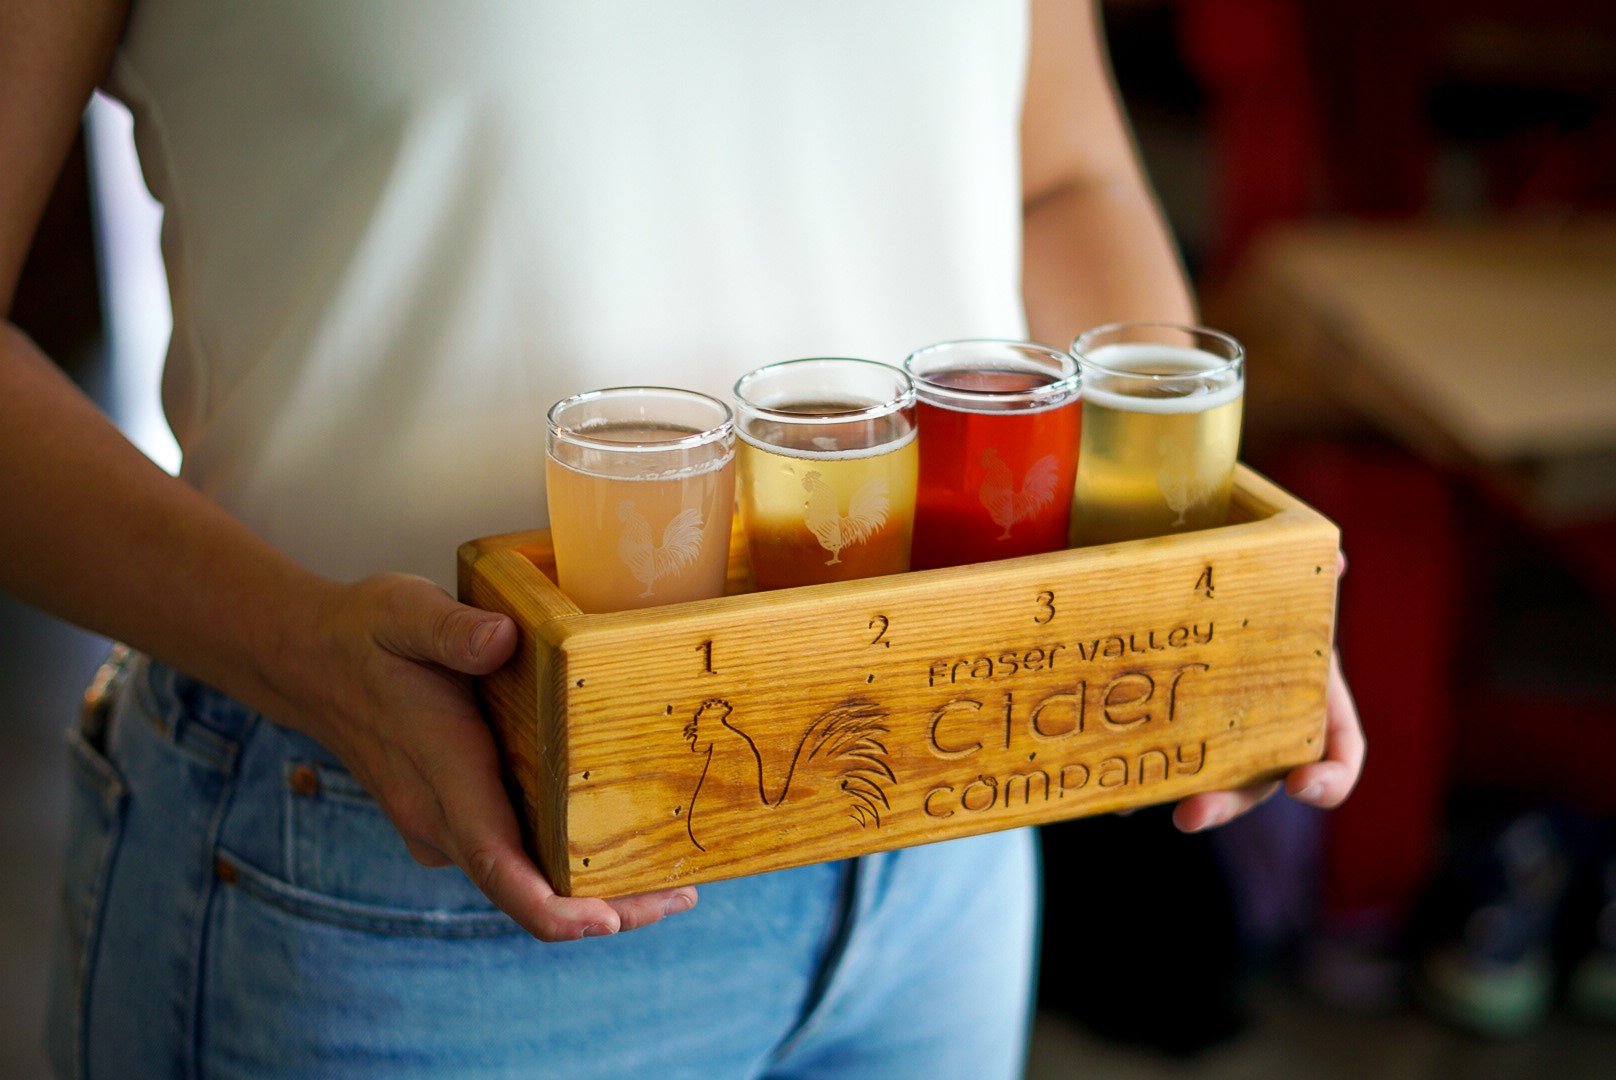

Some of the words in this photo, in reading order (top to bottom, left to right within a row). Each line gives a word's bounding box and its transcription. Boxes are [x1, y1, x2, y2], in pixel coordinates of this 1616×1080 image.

[1194, 565, 1215, 599] 4
[1034, 590, 1056, 624] 3
[868, 614, 890, 648] 2
[694, 639, 718, 675] 1
[928, 644, 1066, 687] Fraser
